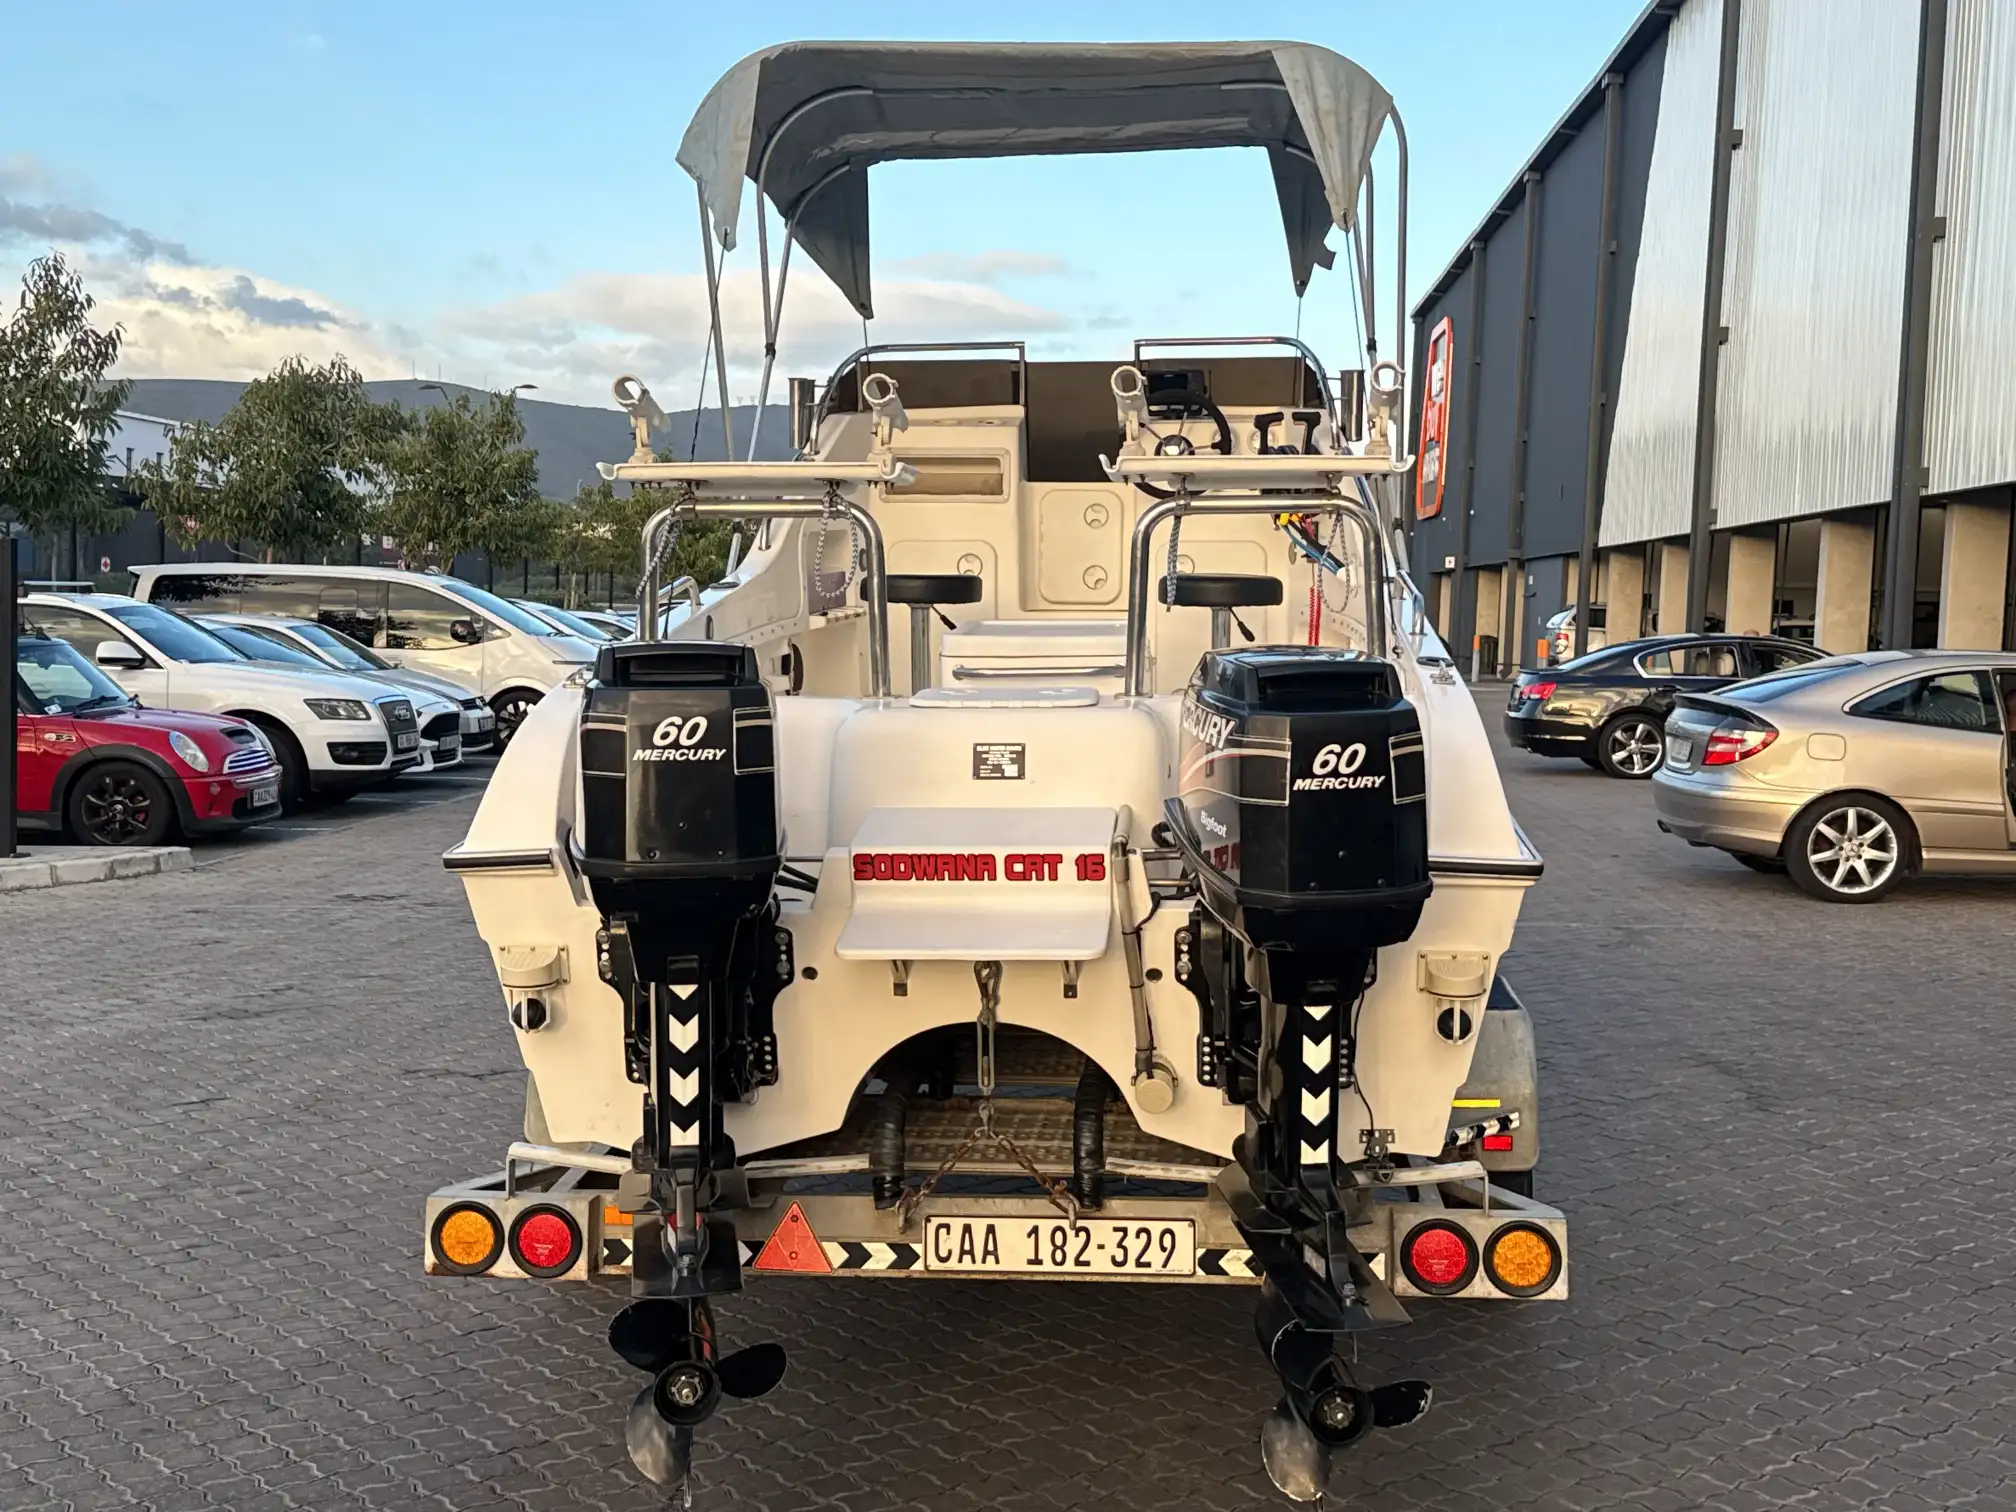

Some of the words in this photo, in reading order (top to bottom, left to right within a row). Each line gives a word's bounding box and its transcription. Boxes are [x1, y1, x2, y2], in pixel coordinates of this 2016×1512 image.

[652, 715, 708, 747] 60
[632, 748, 727, 761] MERCURY
[1312, 742, 1367, 775] 60
[1292, 774, 1386, 791] MERCURY
[853, 854, 997, 881] SODWANA
[1005, 854, 1063, 881] CAT
[1075, 854, 1106, 881] 16
[933, 1222, 1000, 1265] CAA
[1026, 1224, 1177, 1269] 182-329
